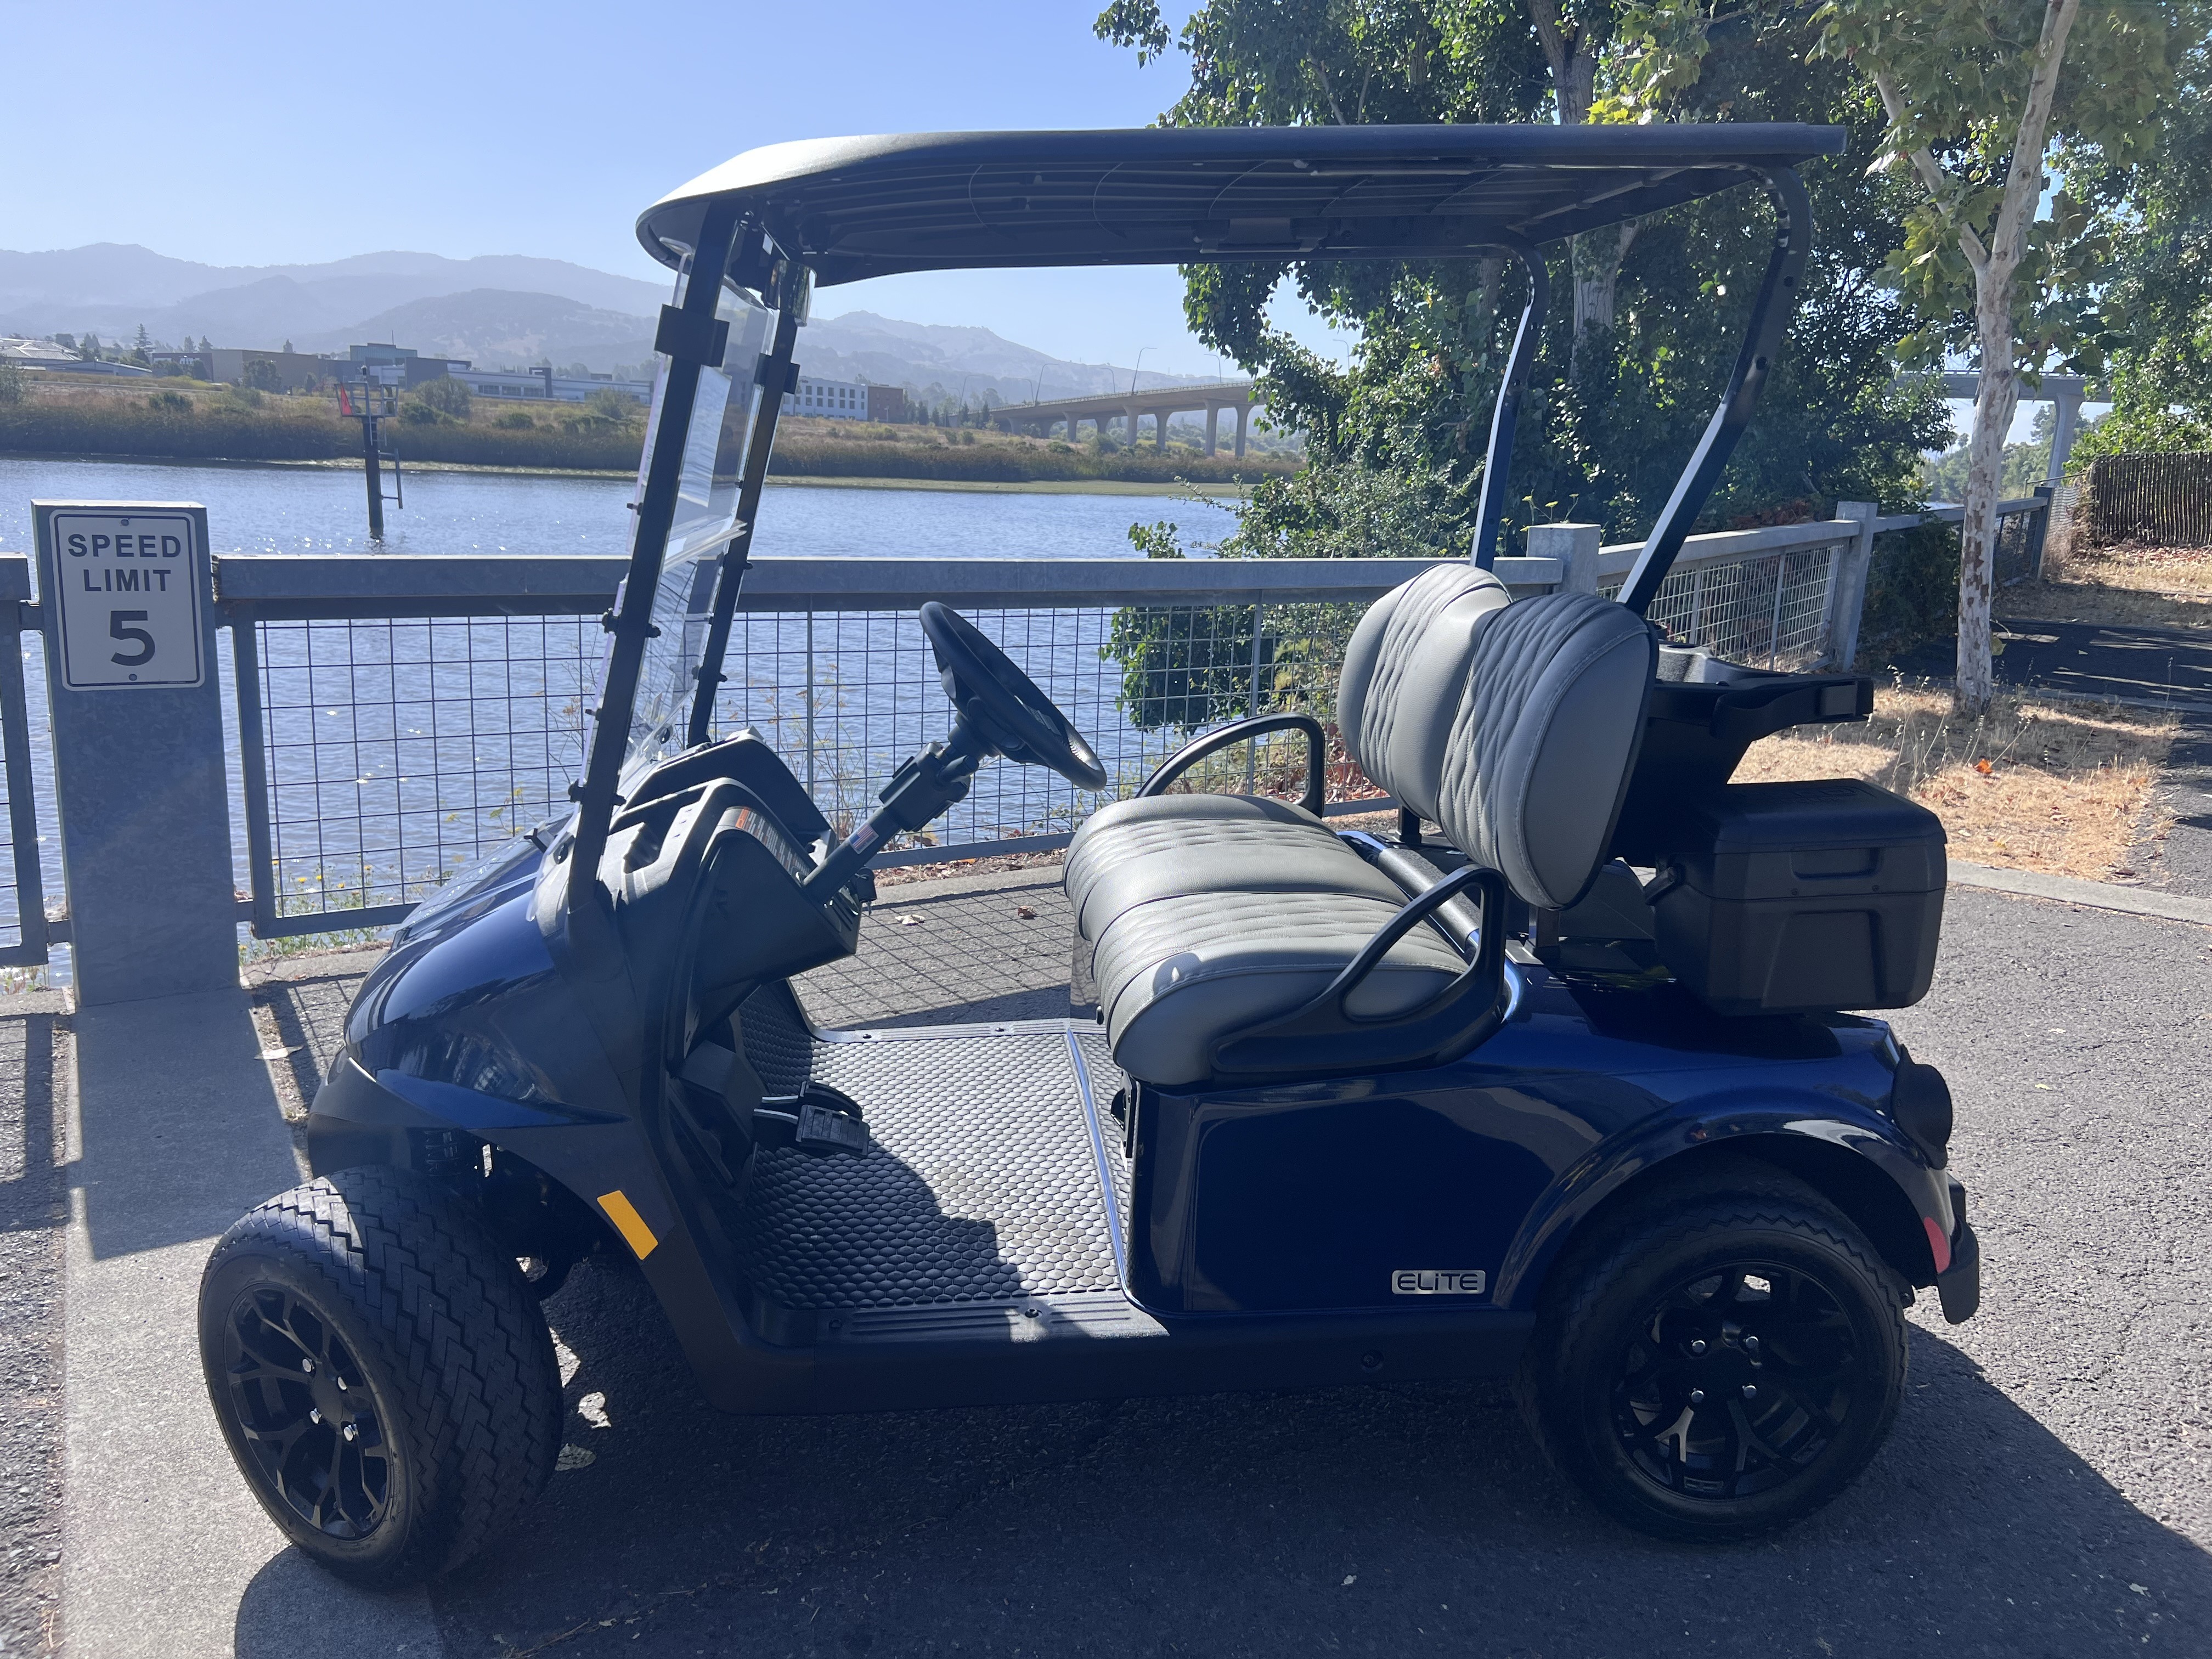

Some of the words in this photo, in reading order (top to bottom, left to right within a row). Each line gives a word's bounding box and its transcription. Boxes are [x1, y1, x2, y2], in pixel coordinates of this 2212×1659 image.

[67, 534, 181, 558] SPEED
[83, 569, 171, 591] LIMIT
[110, 610, 155, 666] 5
